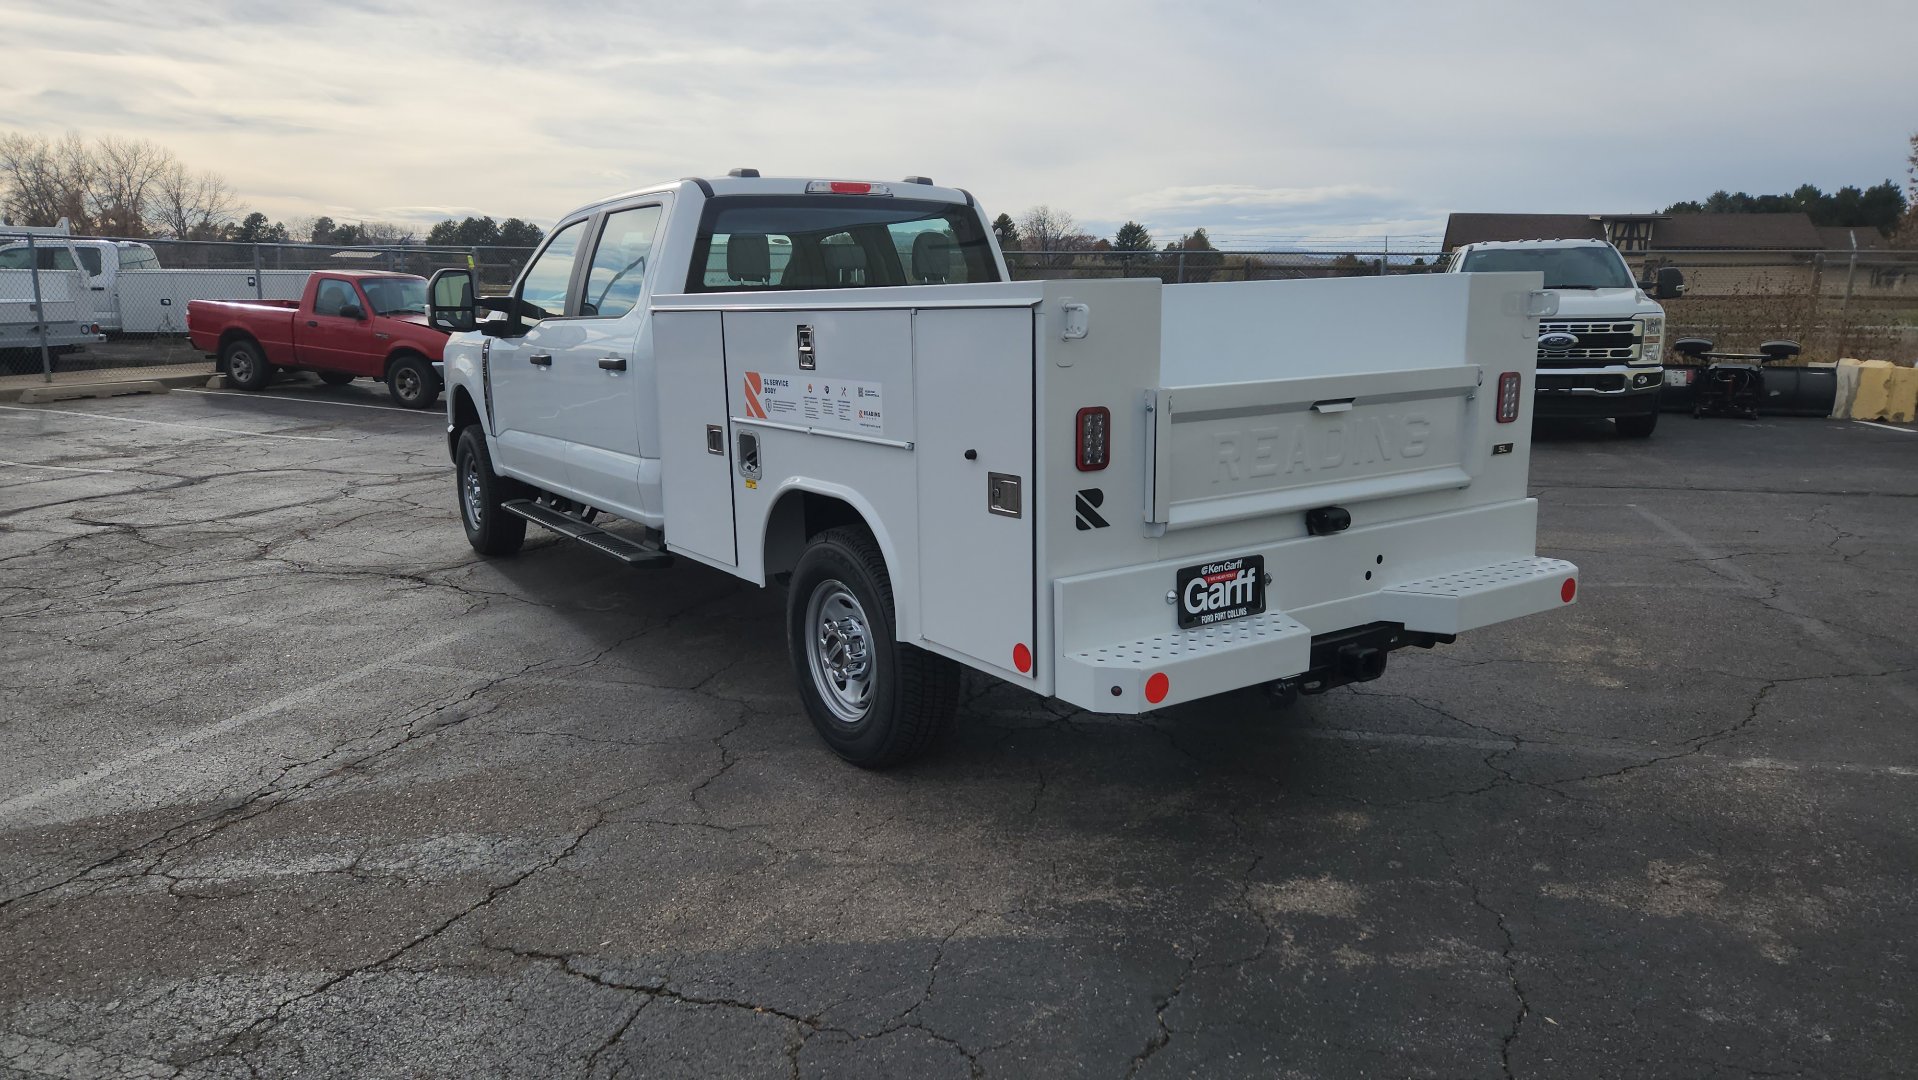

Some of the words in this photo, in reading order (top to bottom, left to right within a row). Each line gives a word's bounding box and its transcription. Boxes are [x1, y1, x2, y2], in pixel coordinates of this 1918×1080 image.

[769, 379, 789, 387] SERVICE
[863, 410, 881, 418] READING
[1211, 412, 1431, 484] READING
[1497, 444, 1508, 453] SL
[1208, 563, 1224, 573] Ken
[1223, 559, 1243, 572] Garff
[1184, 567, 1256, 614] Garff
[1201, 614, 1214, 624] FORD
[1214, 611, 1227, 621] FORT
[1227, 607, 1248, 619] COLLINS
